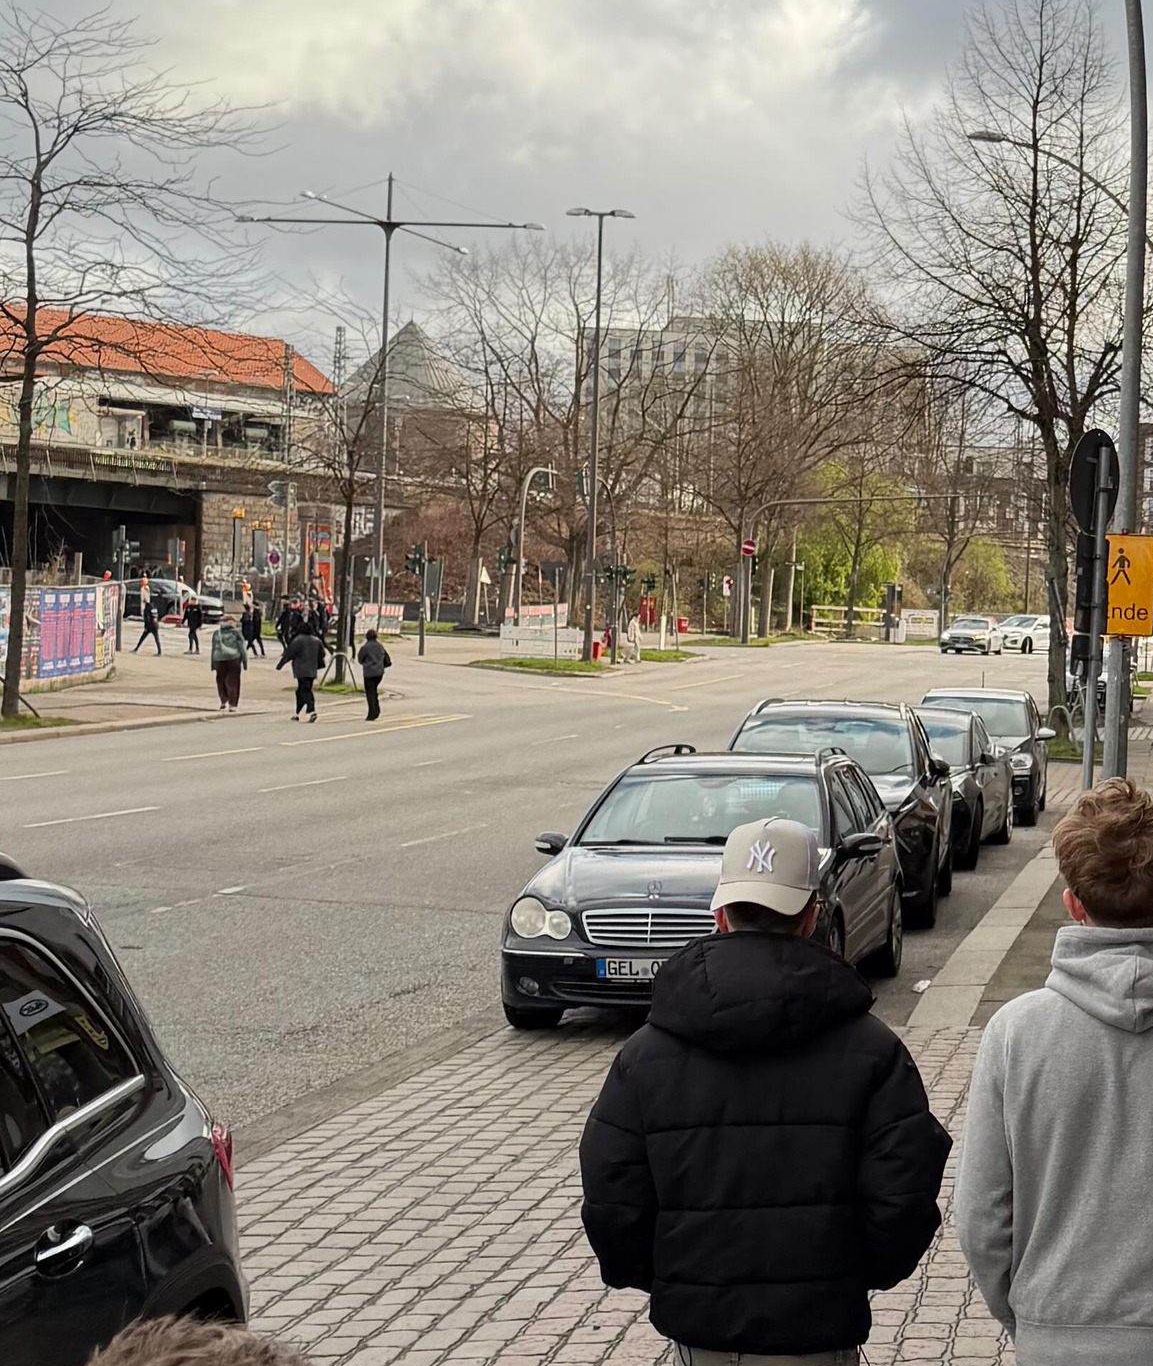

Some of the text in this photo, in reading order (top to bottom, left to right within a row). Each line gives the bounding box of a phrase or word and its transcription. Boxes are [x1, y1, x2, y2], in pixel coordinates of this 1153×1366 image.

[1107, 603, 1149, 621] nde
[747, 839, 776, 873] NY
[607, 960, 640, 976] GEL
